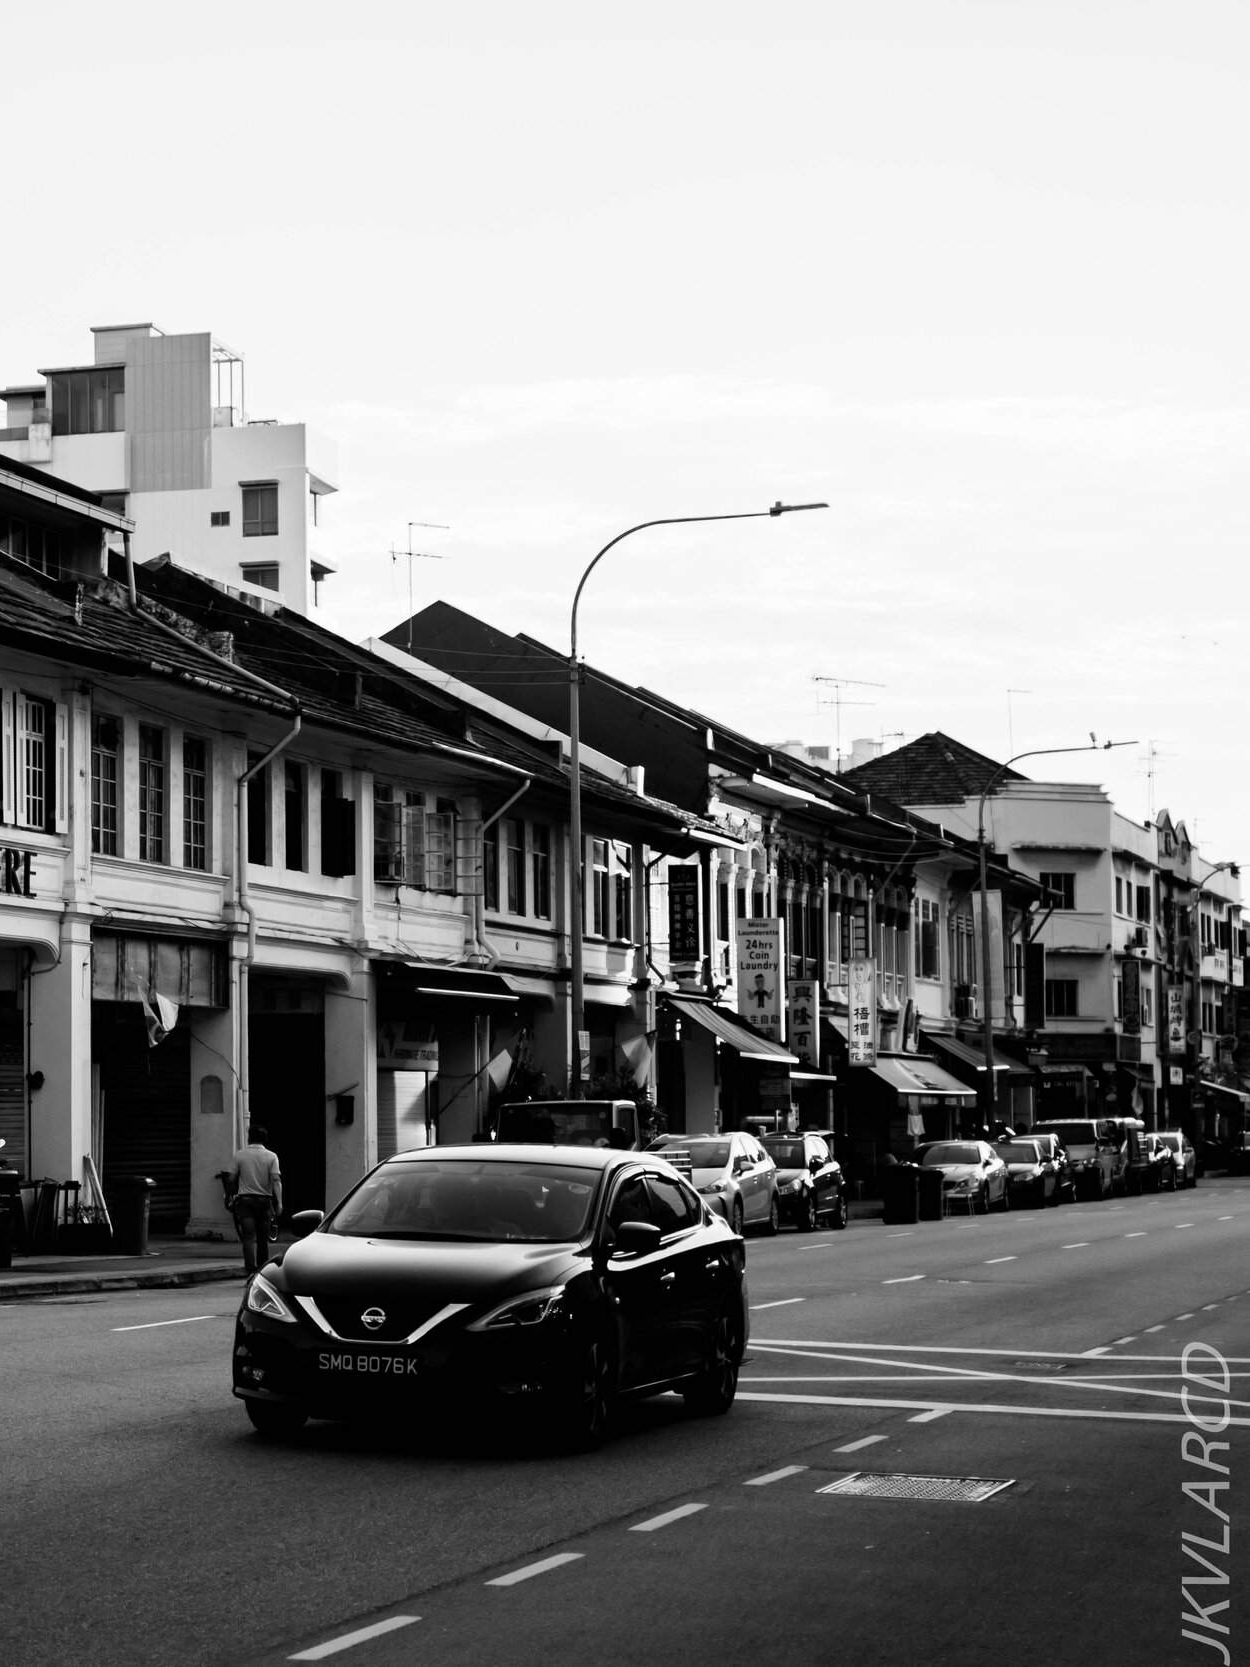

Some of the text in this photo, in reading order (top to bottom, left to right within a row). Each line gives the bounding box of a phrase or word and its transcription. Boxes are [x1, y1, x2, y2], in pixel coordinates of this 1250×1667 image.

[749, 951, 769, 960] Coin
[740, 961, 779, 972] Laundry
[319, 1353, 418, 1375] SMQ 8076K
